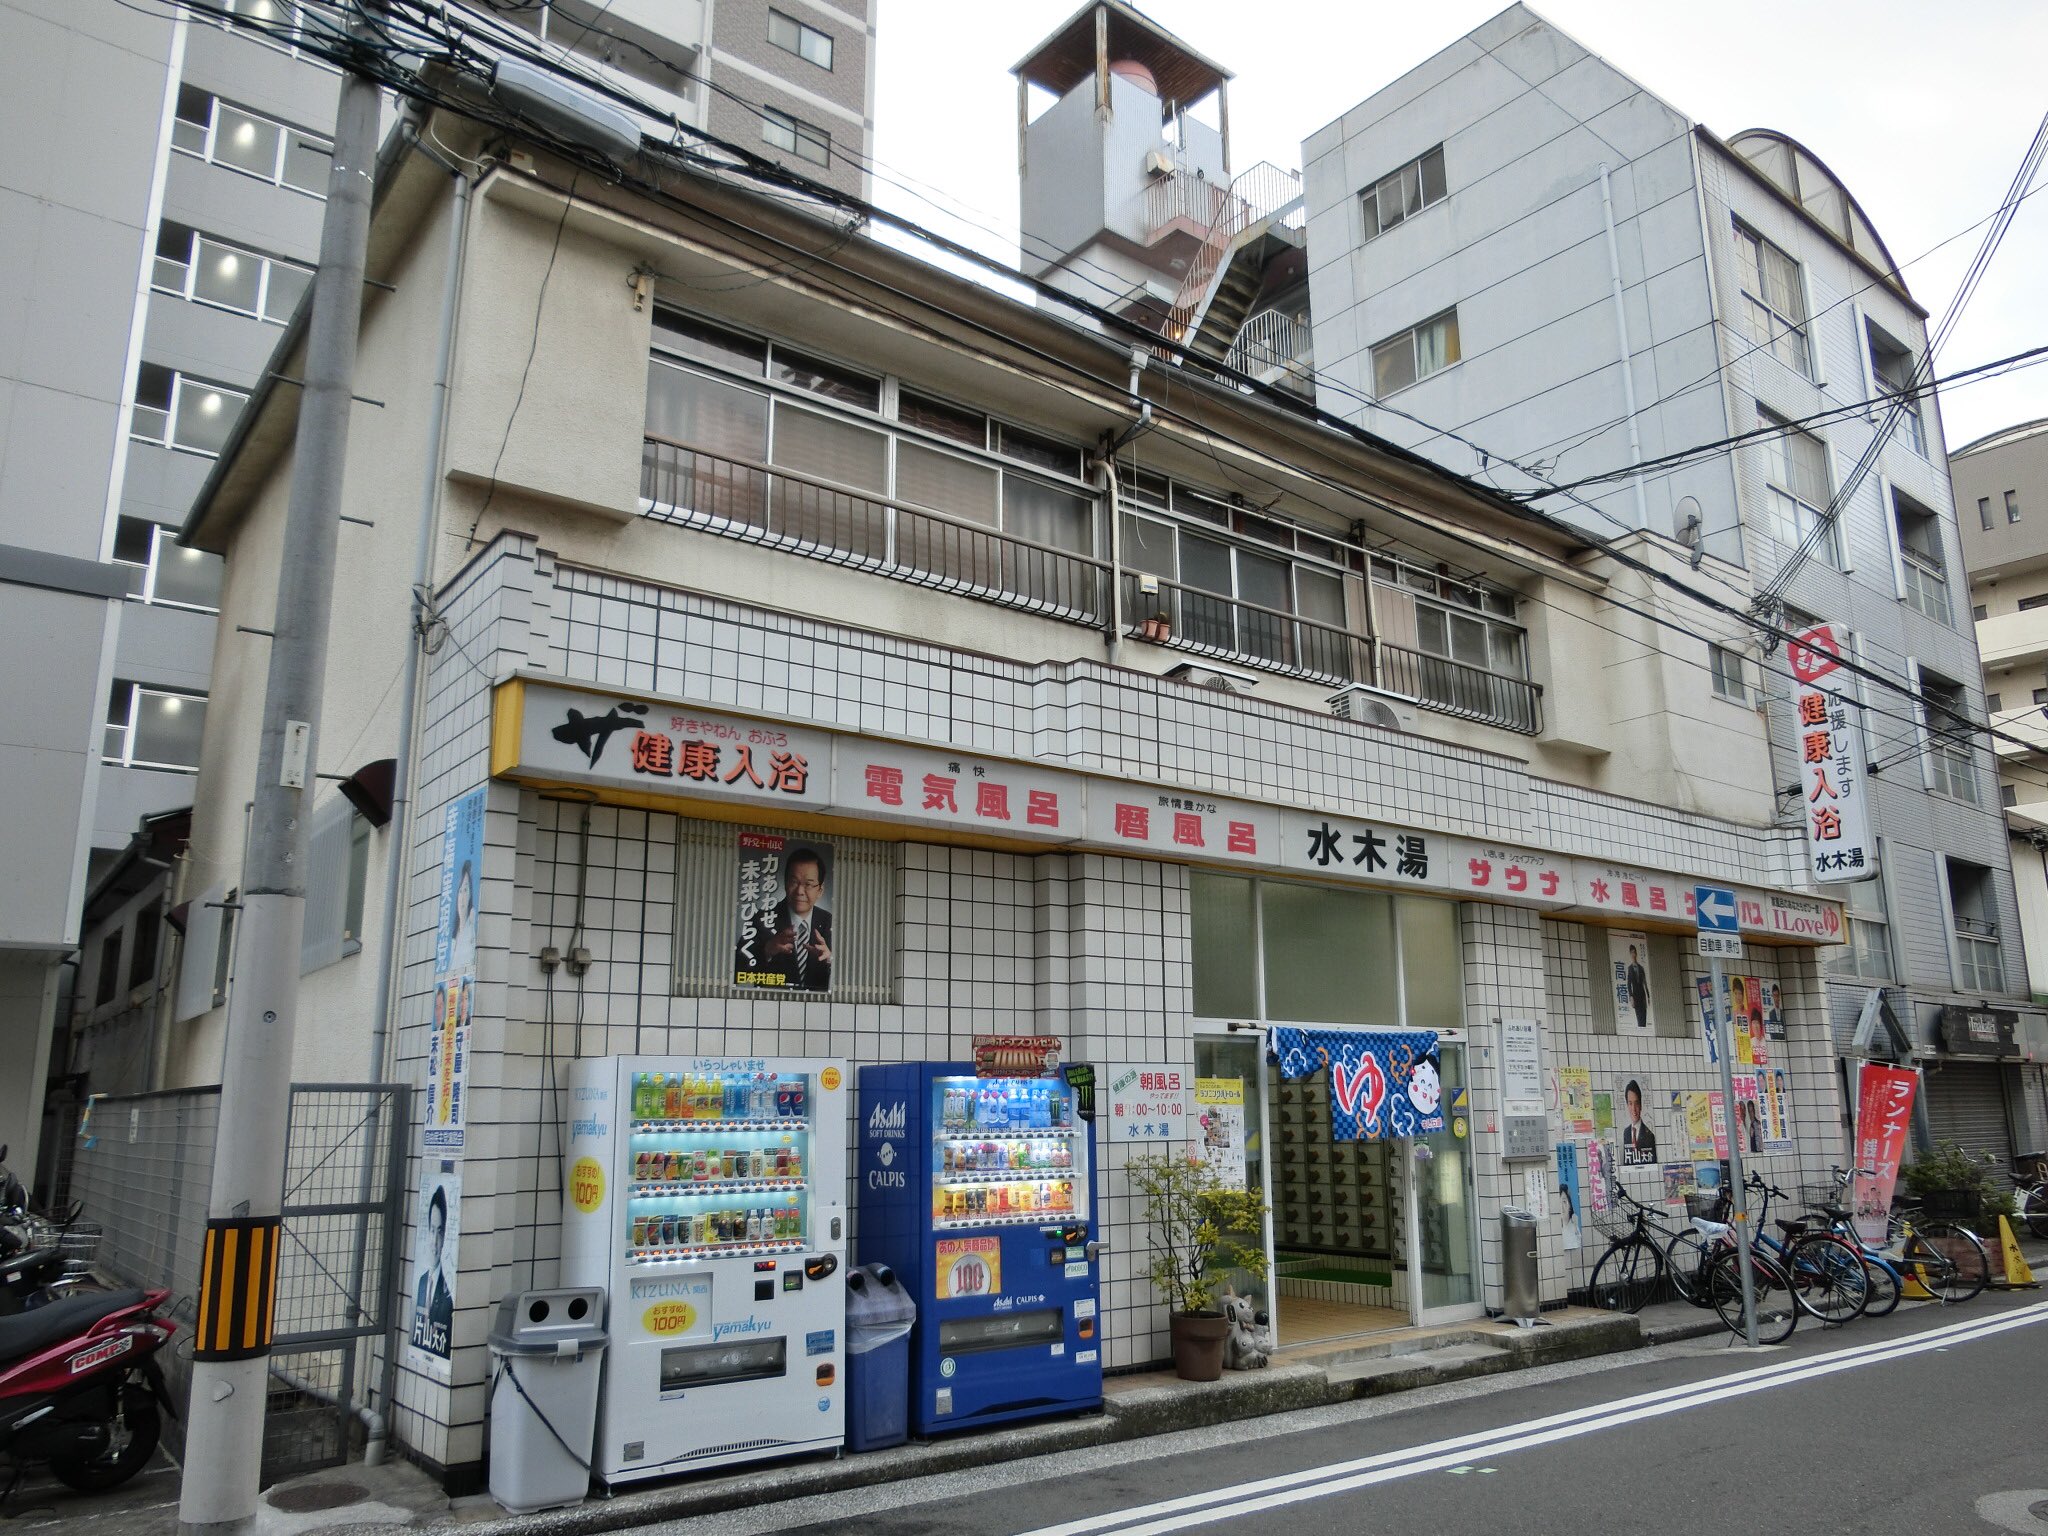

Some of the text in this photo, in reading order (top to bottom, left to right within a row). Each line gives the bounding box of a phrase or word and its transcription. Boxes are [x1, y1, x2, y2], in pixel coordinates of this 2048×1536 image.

[670, 715, 788, 748] 好きやねん おふろ
[630, 729, 808, 796] 健康入浴
[947, 760, 986, 778] 痛快
[1798, 692, 1842, 842] 健康入浴
[864, 764, 1060, 828] 電気風呂
[1158, 795, 1217, 814] 旅情豊かな
[1307, 822, 1429, 880] 水木湯
[1815, 847, 1865, 873] 水木湯
[1468, 858, 1560, 896] サウナ
[760, 853, 780, 936] 力あわせ、
[1590, 878, 1668, 911] 水風呂
[740, 859, 760, 967] 未来ひらく。
[737, 971, 786, 986] 日本共産党
[693, 1059, 766, 1071] いらっしゃいませ
[1140, 1072, 1180, 1091] 朝風呂
[1334, 1051, 1386, 1127] ゆ
[869, 1101, 906, 1129] Asahi
[869, 1129, 905, 1138] SOFT DRINKS
[1128, 1123, 1169, 1138] 水木湯
[1877, 1080, 1910, 1180] ランナーズ
[1624, 1148, 1653, 1165] 片山大介
[869, 1170, 905, 1190] CALPIS
[939, 1238, 1000, 1254] あの人気商品が!
[631, 1282, 691, 1299] KIZUNA
[993, 1295, 1038, 1307] Asahi CALPIS
[653, 1303, 687, 1316] おすすめ!
[413, 1315, 447, 1353] 片山大介
[653, 1315, 687, 1331] 100円
[713, 1316, 772, 1342] yamakyu
[74, 1343, 119, 1370] COMP
